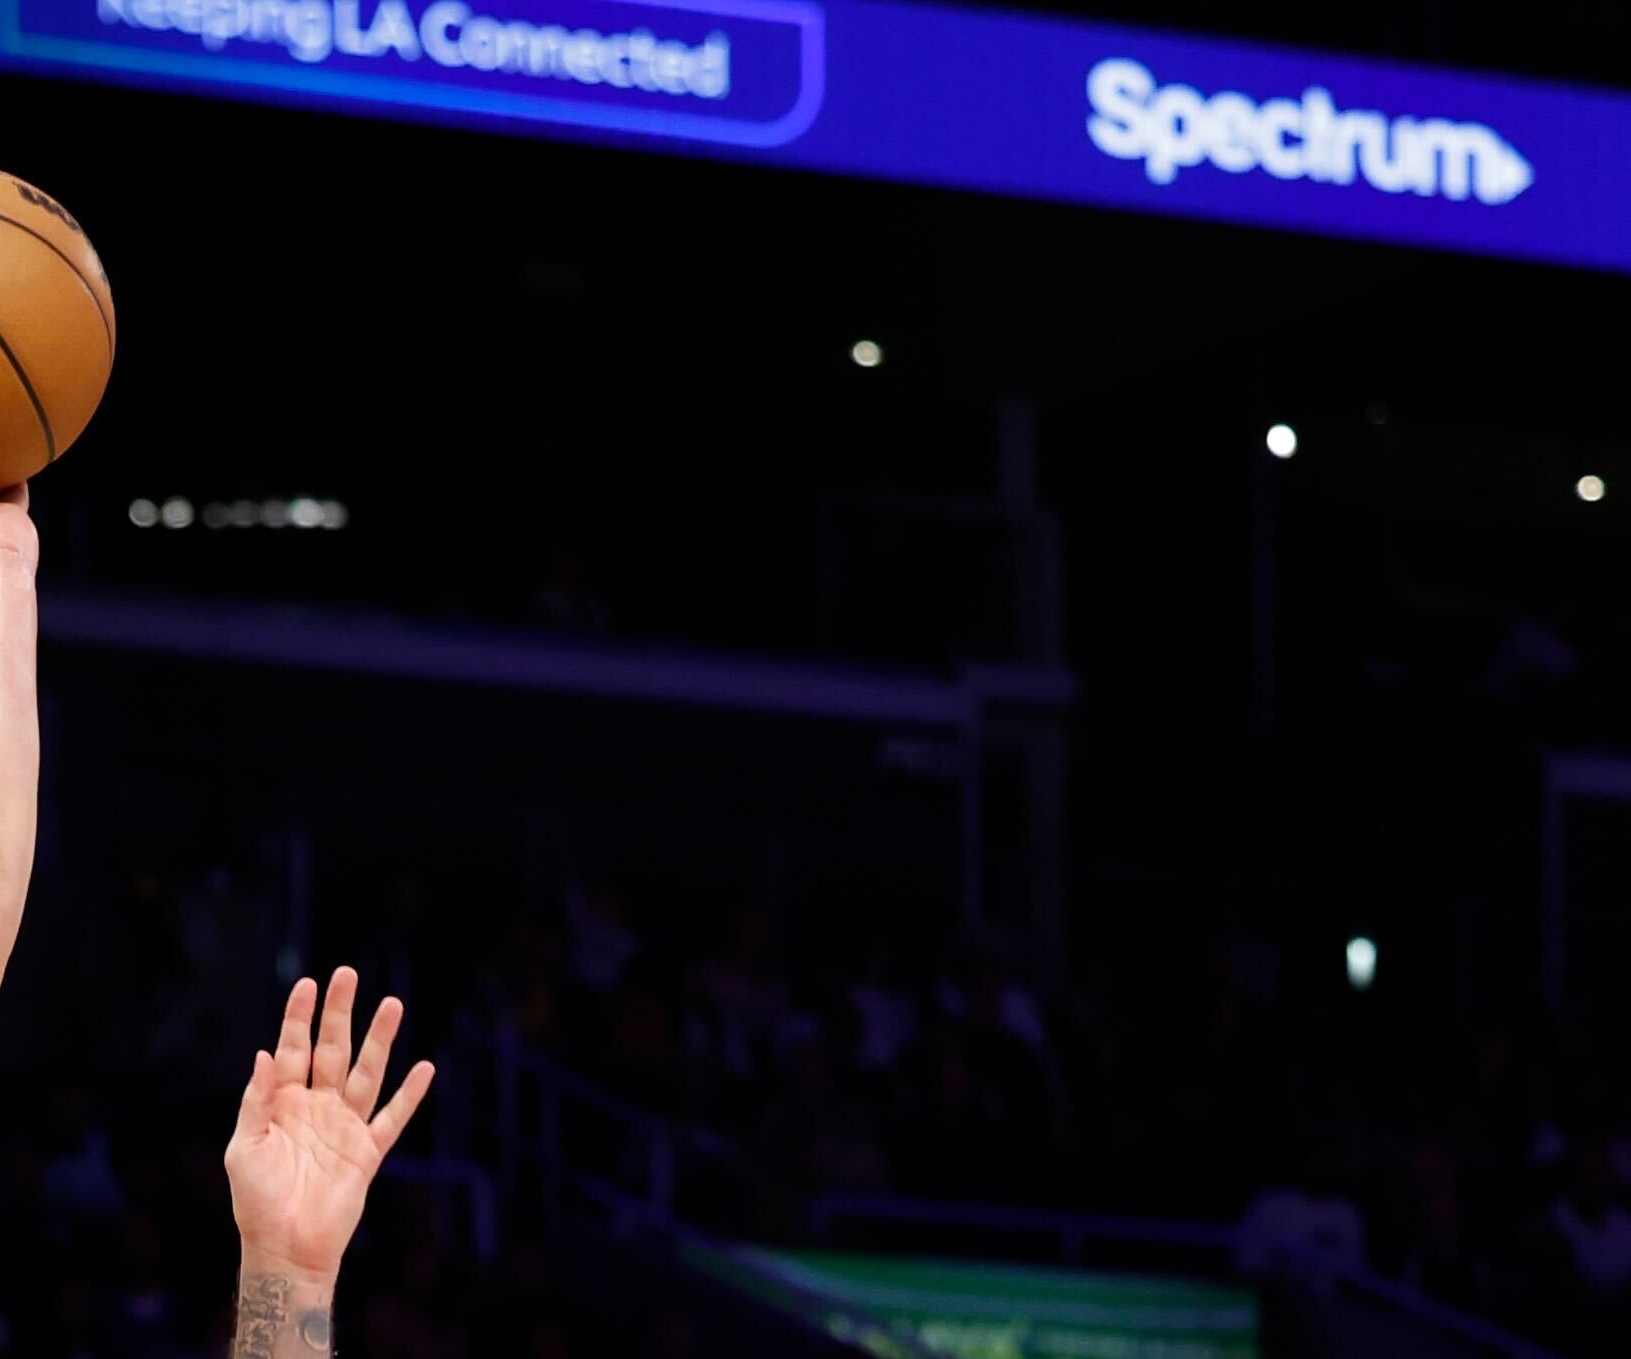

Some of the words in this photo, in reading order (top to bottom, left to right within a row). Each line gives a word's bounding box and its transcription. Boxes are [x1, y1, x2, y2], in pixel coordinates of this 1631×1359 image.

[334, 0, 421, 61] LA
[419, 0, 731, 98] Connected
[1086, 57, 1535, 206] Spectrum
